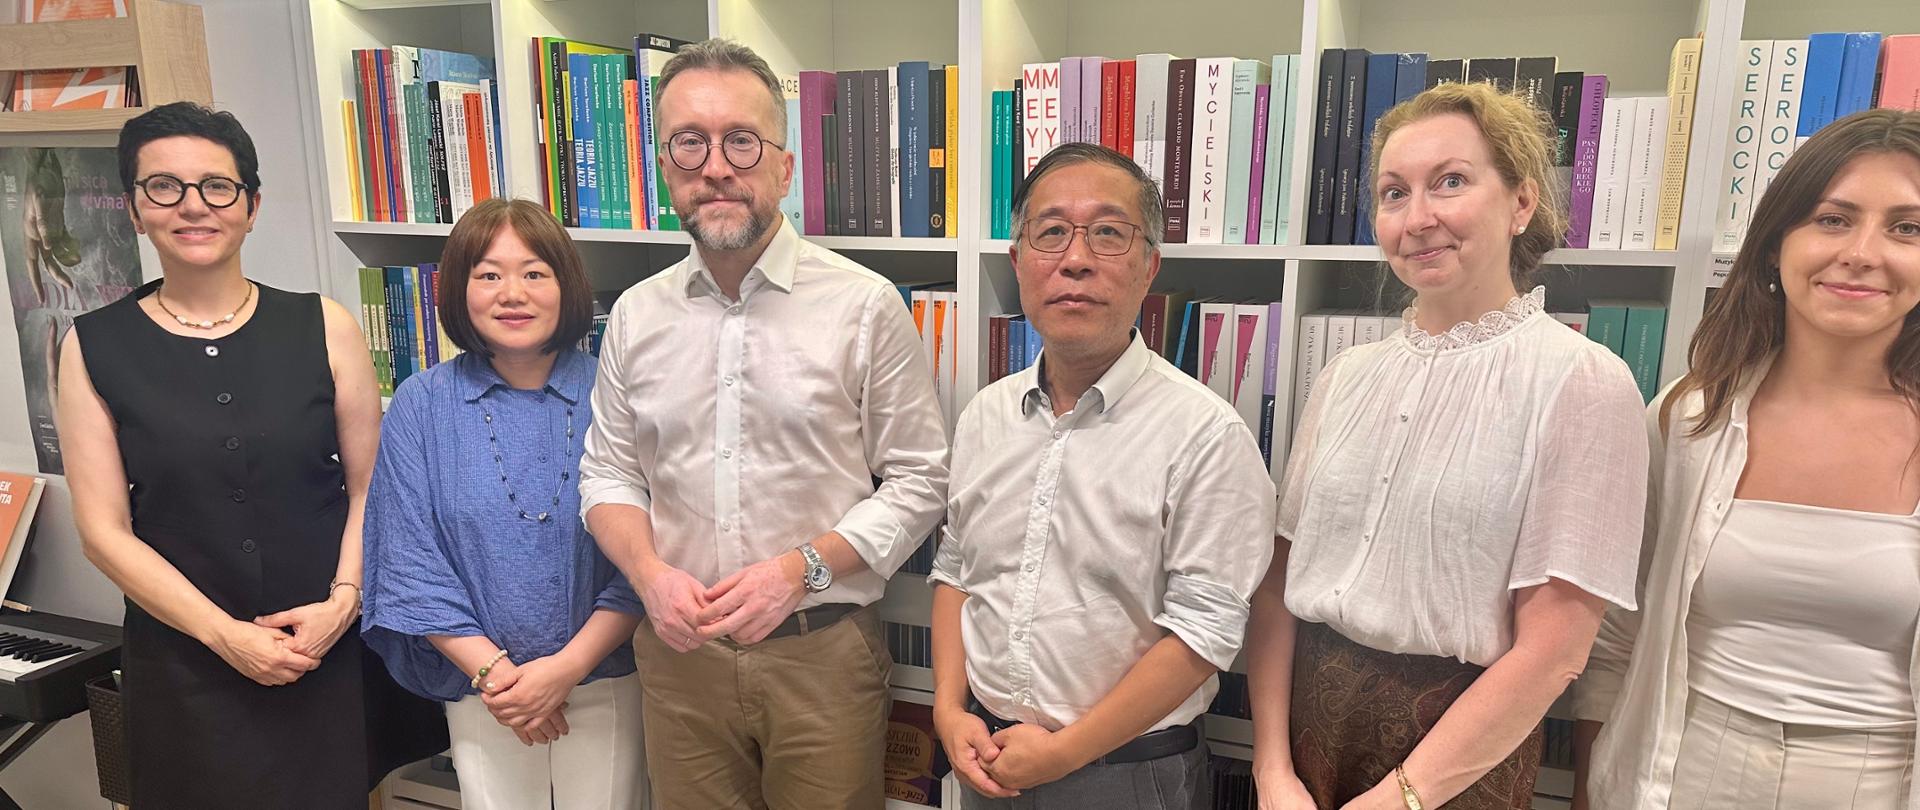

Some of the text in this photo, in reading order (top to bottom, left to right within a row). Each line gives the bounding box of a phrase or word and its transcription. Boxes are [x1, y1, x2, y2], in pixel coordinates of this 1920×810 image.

[644, 79, 652, 97] JAZZ
[645, 98, 653, 145] COMPOSITION
[1042, 67, 1058, 148] MEY
[1589, 82, 1602, 135] CHŁOPECKI
[1767, 47, 1797, 189] SEROC
[1176, 112, 1184, 143] CLAUDIO
[1203, 65, 1220, 220] MYCIELSKI
[1730, 47, 1761, 220] SEROCKI
[574, 138, 585, 166] TEORIA
[585, 139, 595, 166] TEORIA
[1173, 145, 1182, 190] MONTEVERDI
[576, 167, 586, 187] JAZZU
[588, 166, 596, 188] JAZZU
[1307, 325, 1315, 354] MUZYKA
